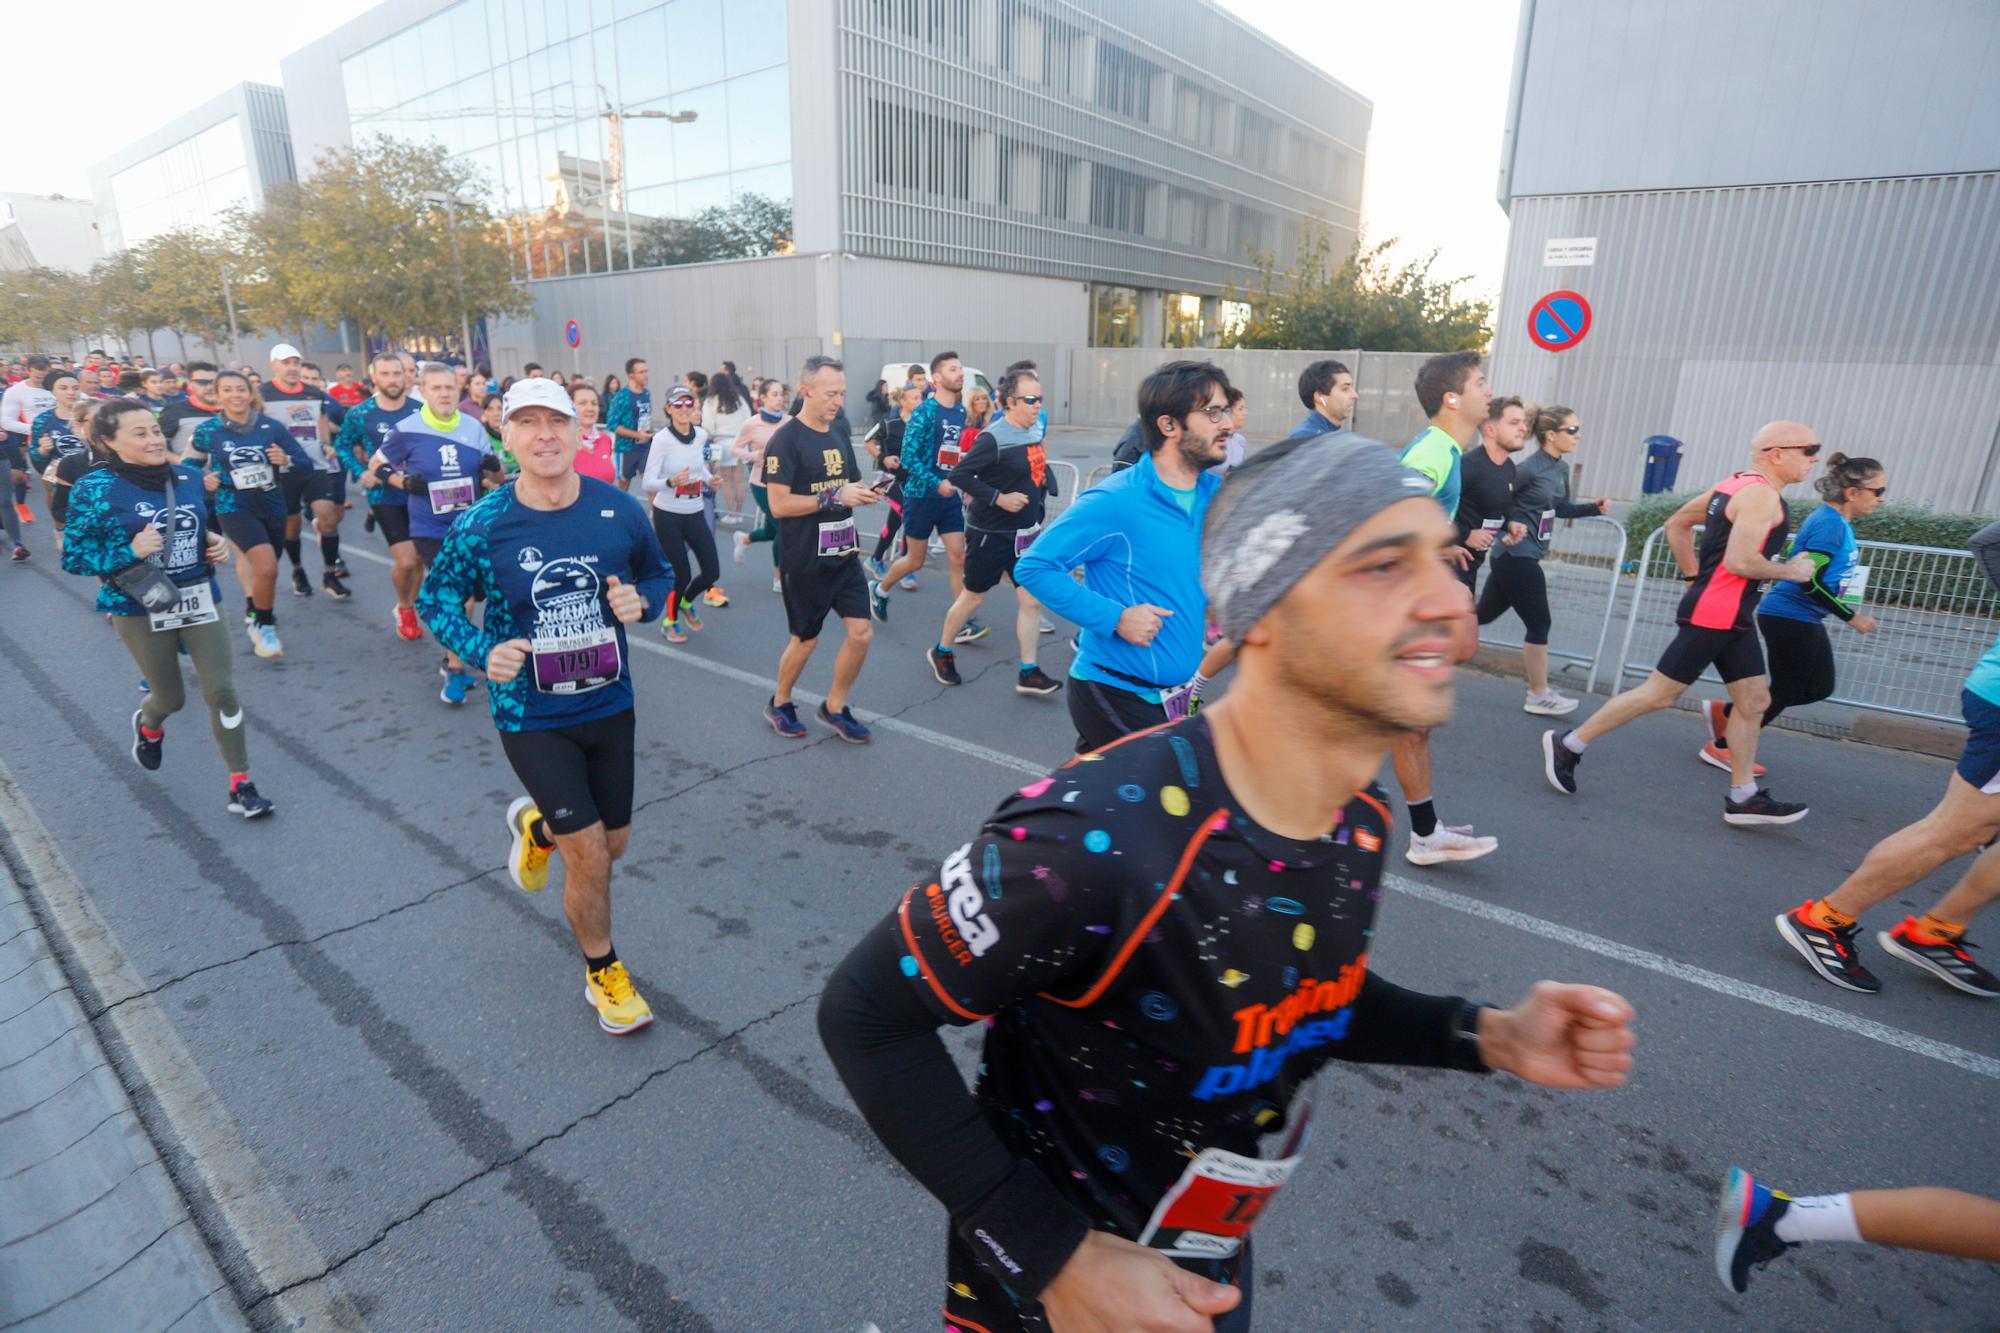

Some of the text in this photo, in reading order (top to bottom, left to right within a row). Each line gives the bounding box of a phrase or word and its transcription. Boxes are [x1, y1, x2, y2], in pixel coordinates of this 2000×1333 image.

[559, 623, 582, 638] PAS
[583, 618, 607, 635] RAS
[557, 648, 601, 673] 1797
[927, 894, 974, 967] BURGER
